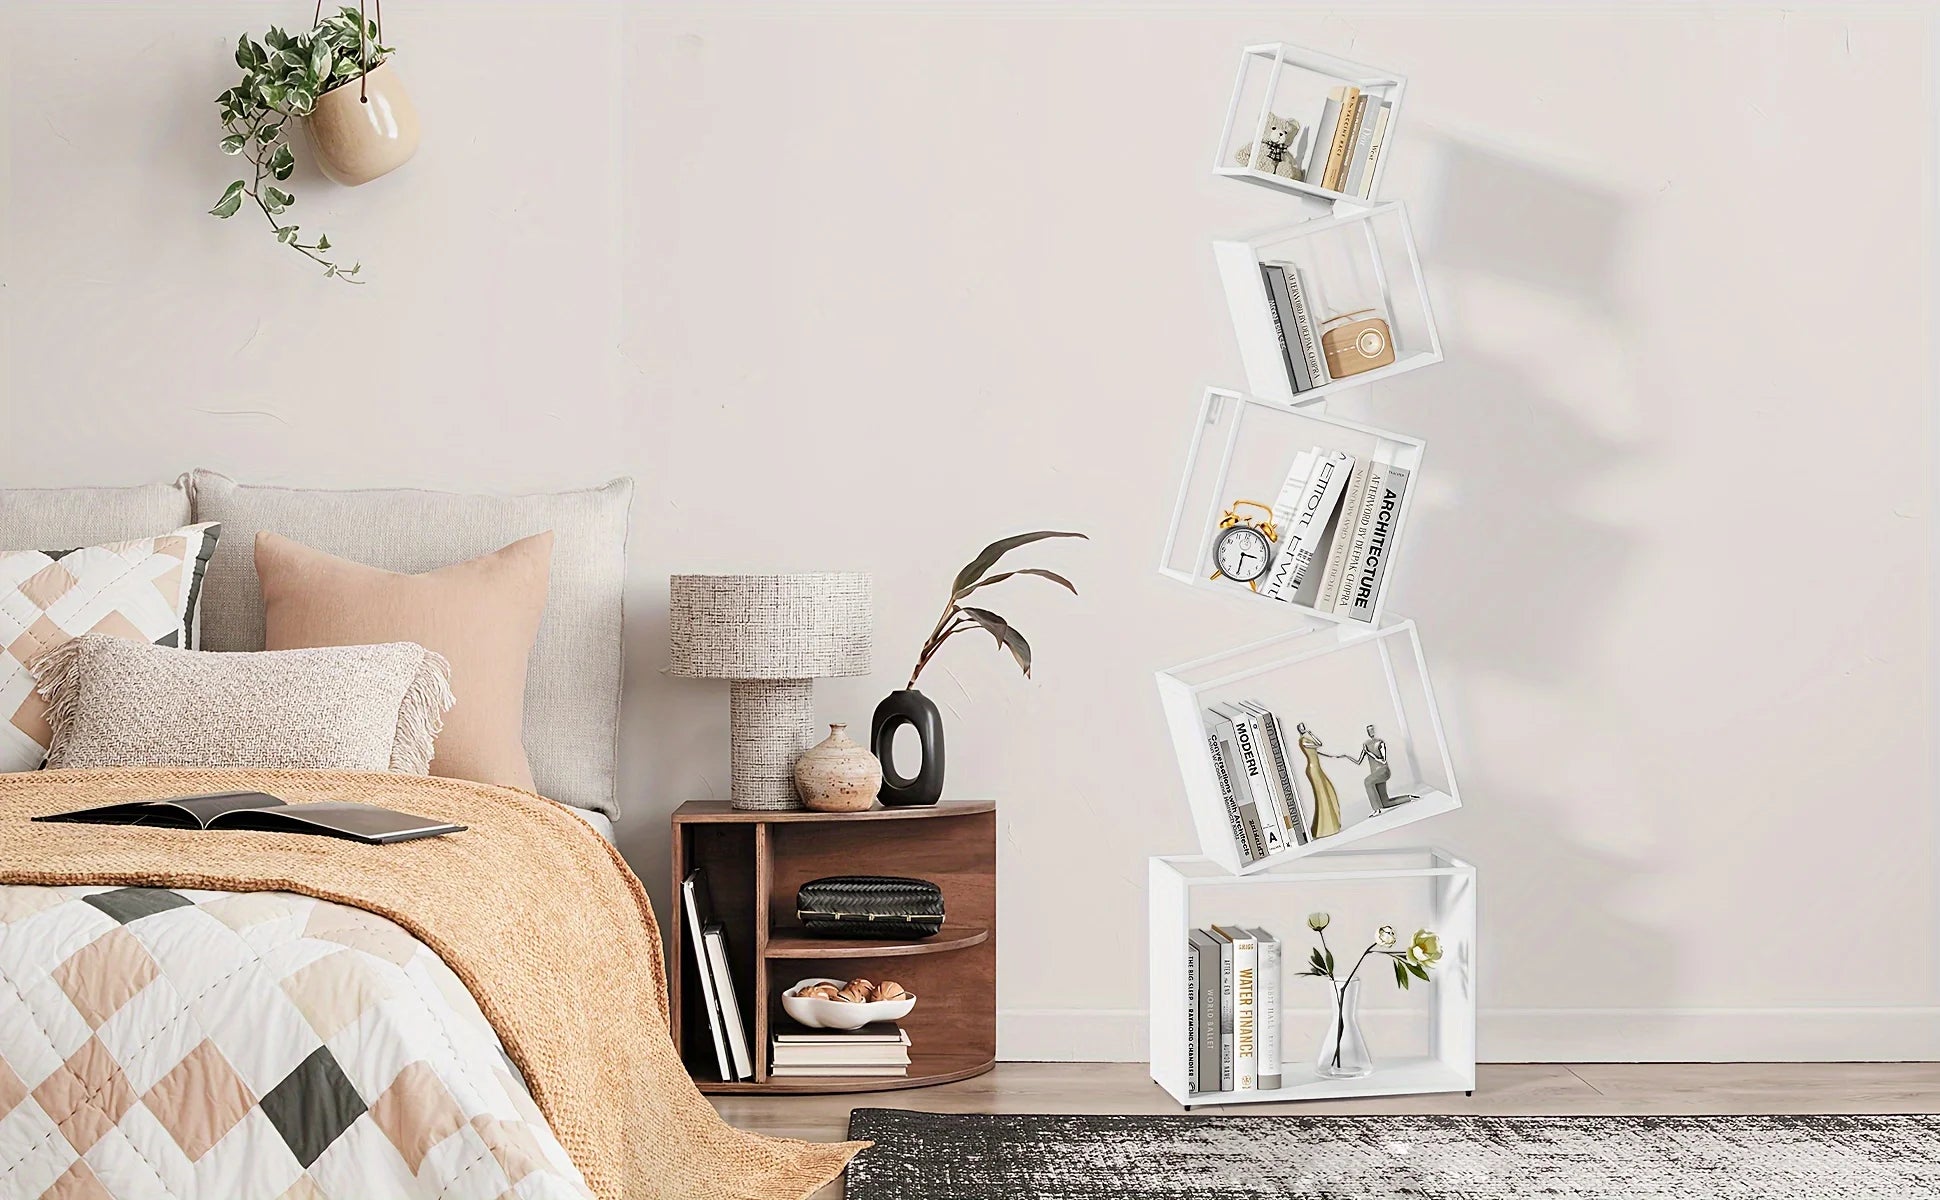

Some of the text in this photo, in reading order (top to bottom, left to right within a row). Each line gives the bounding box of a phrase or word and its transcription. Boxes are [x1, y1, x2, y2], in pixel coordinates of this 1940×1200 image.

[1287, 272, 1320, 379] AFTERWORD BY DEEPAK CHOPRA
[1339, 517, 1350, 539] GRAY
[1345, 468, 1364, 516] MOUNTAIN
[1339, 473, 1380, 607] AFTERWORD BY DEEPAK CHOPRA
[1354, 488, 1397, 609] ARCHITECTURE
[1210, 733, 1250, 856] Conversations with Architects
[1235, 722, 1259, 776] MODERN
[1269, 831, 1278, 843] A
[1239, 968, 1252, 1057] WATER FINANCE
